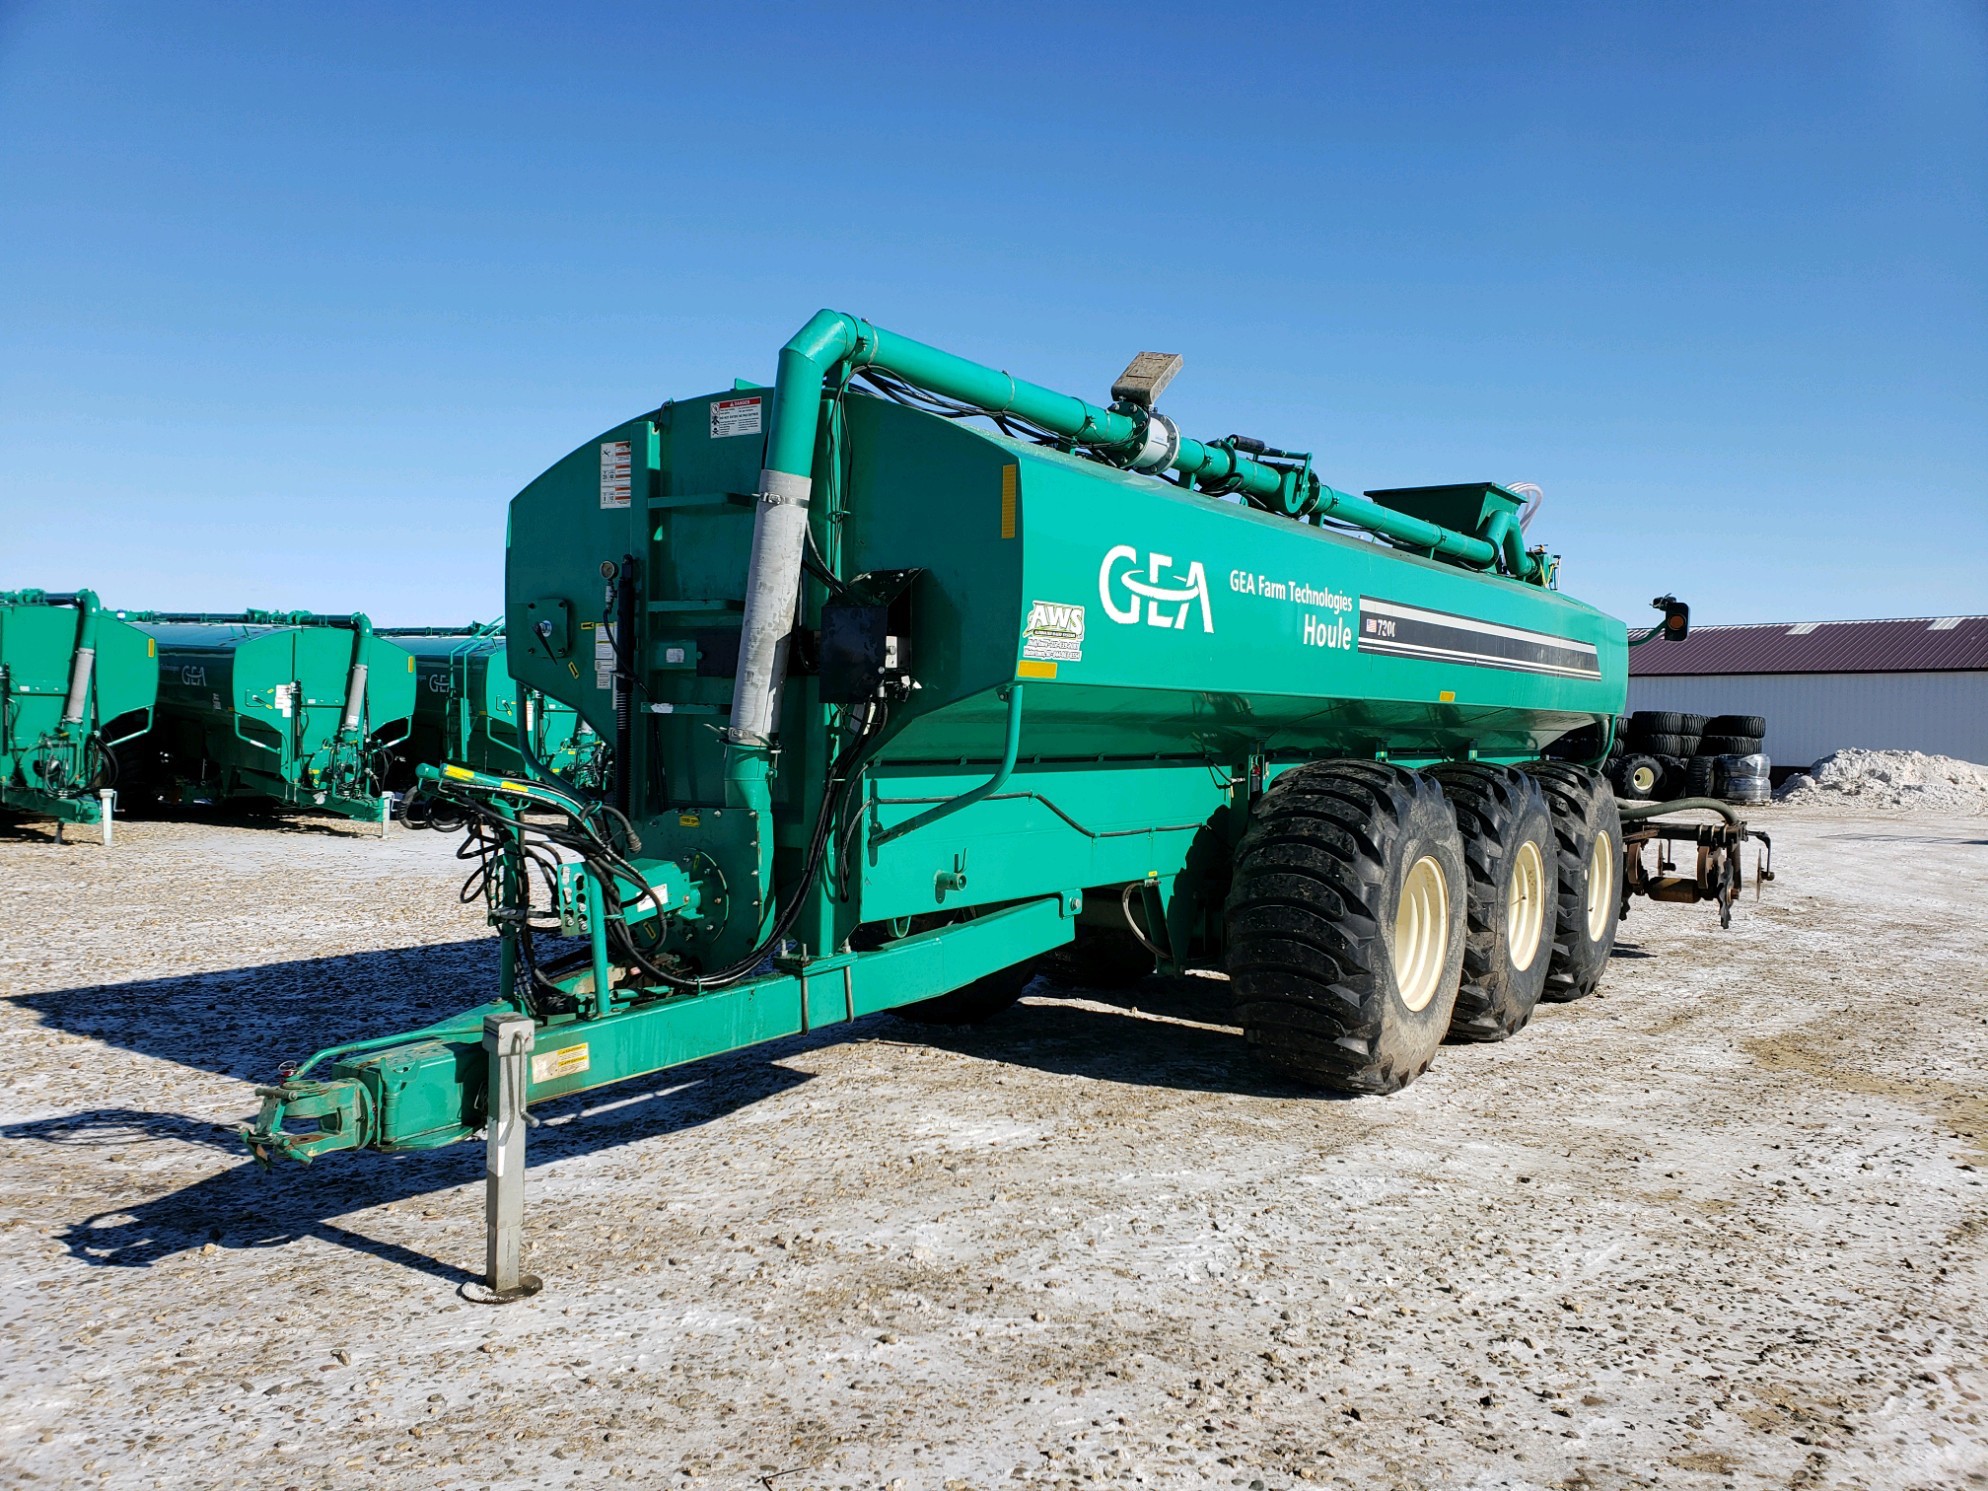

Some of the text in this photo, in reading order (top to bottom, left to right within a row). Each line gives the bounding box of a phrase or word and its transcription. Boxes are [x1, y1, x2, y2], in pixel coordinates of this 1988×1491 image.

[1099, 545, 1214, 633] GEA
[1229, 569, 1353, 615] GEA Farm Technologies
[1029, 603, 1084, 635] AWS
[1303, 613, 1352, 651] Houle
[182, 665, 206, 687] GEA
